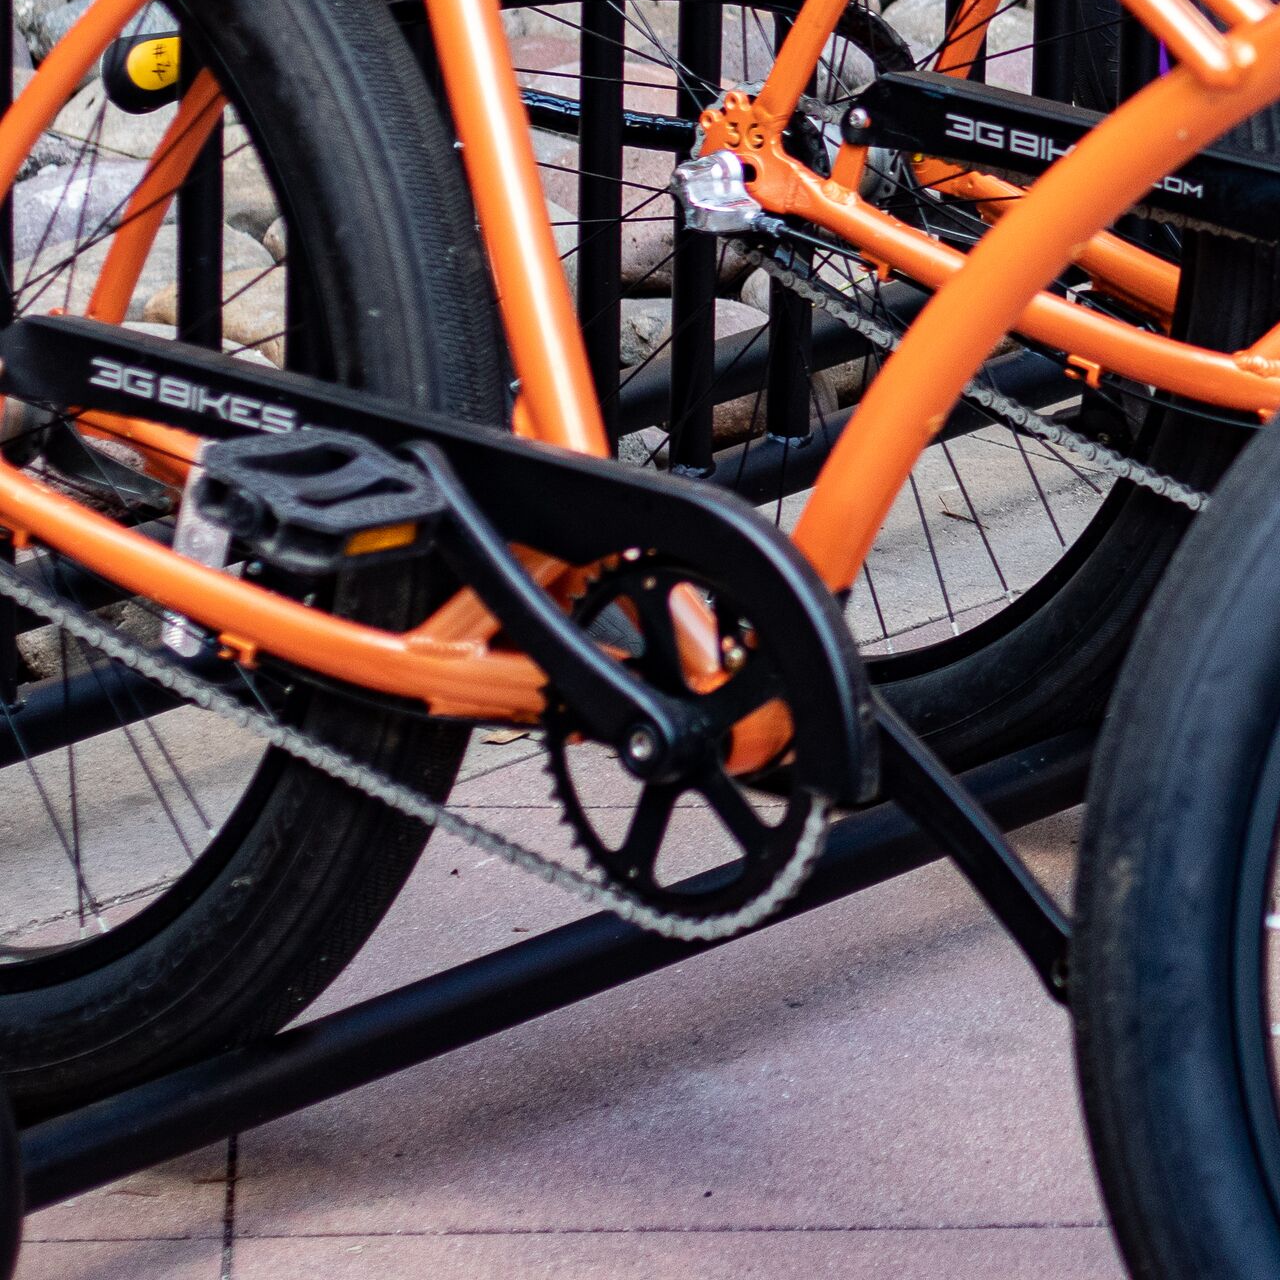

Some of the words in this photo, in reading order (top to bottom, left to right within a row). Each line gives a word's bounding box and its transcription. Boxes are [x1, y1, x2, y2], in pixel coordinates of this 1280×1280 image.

[945, 113, 1005, 149] 3G
[89, 356, 155, 400] 3G
[158, 375, 298, 435] BIKES
